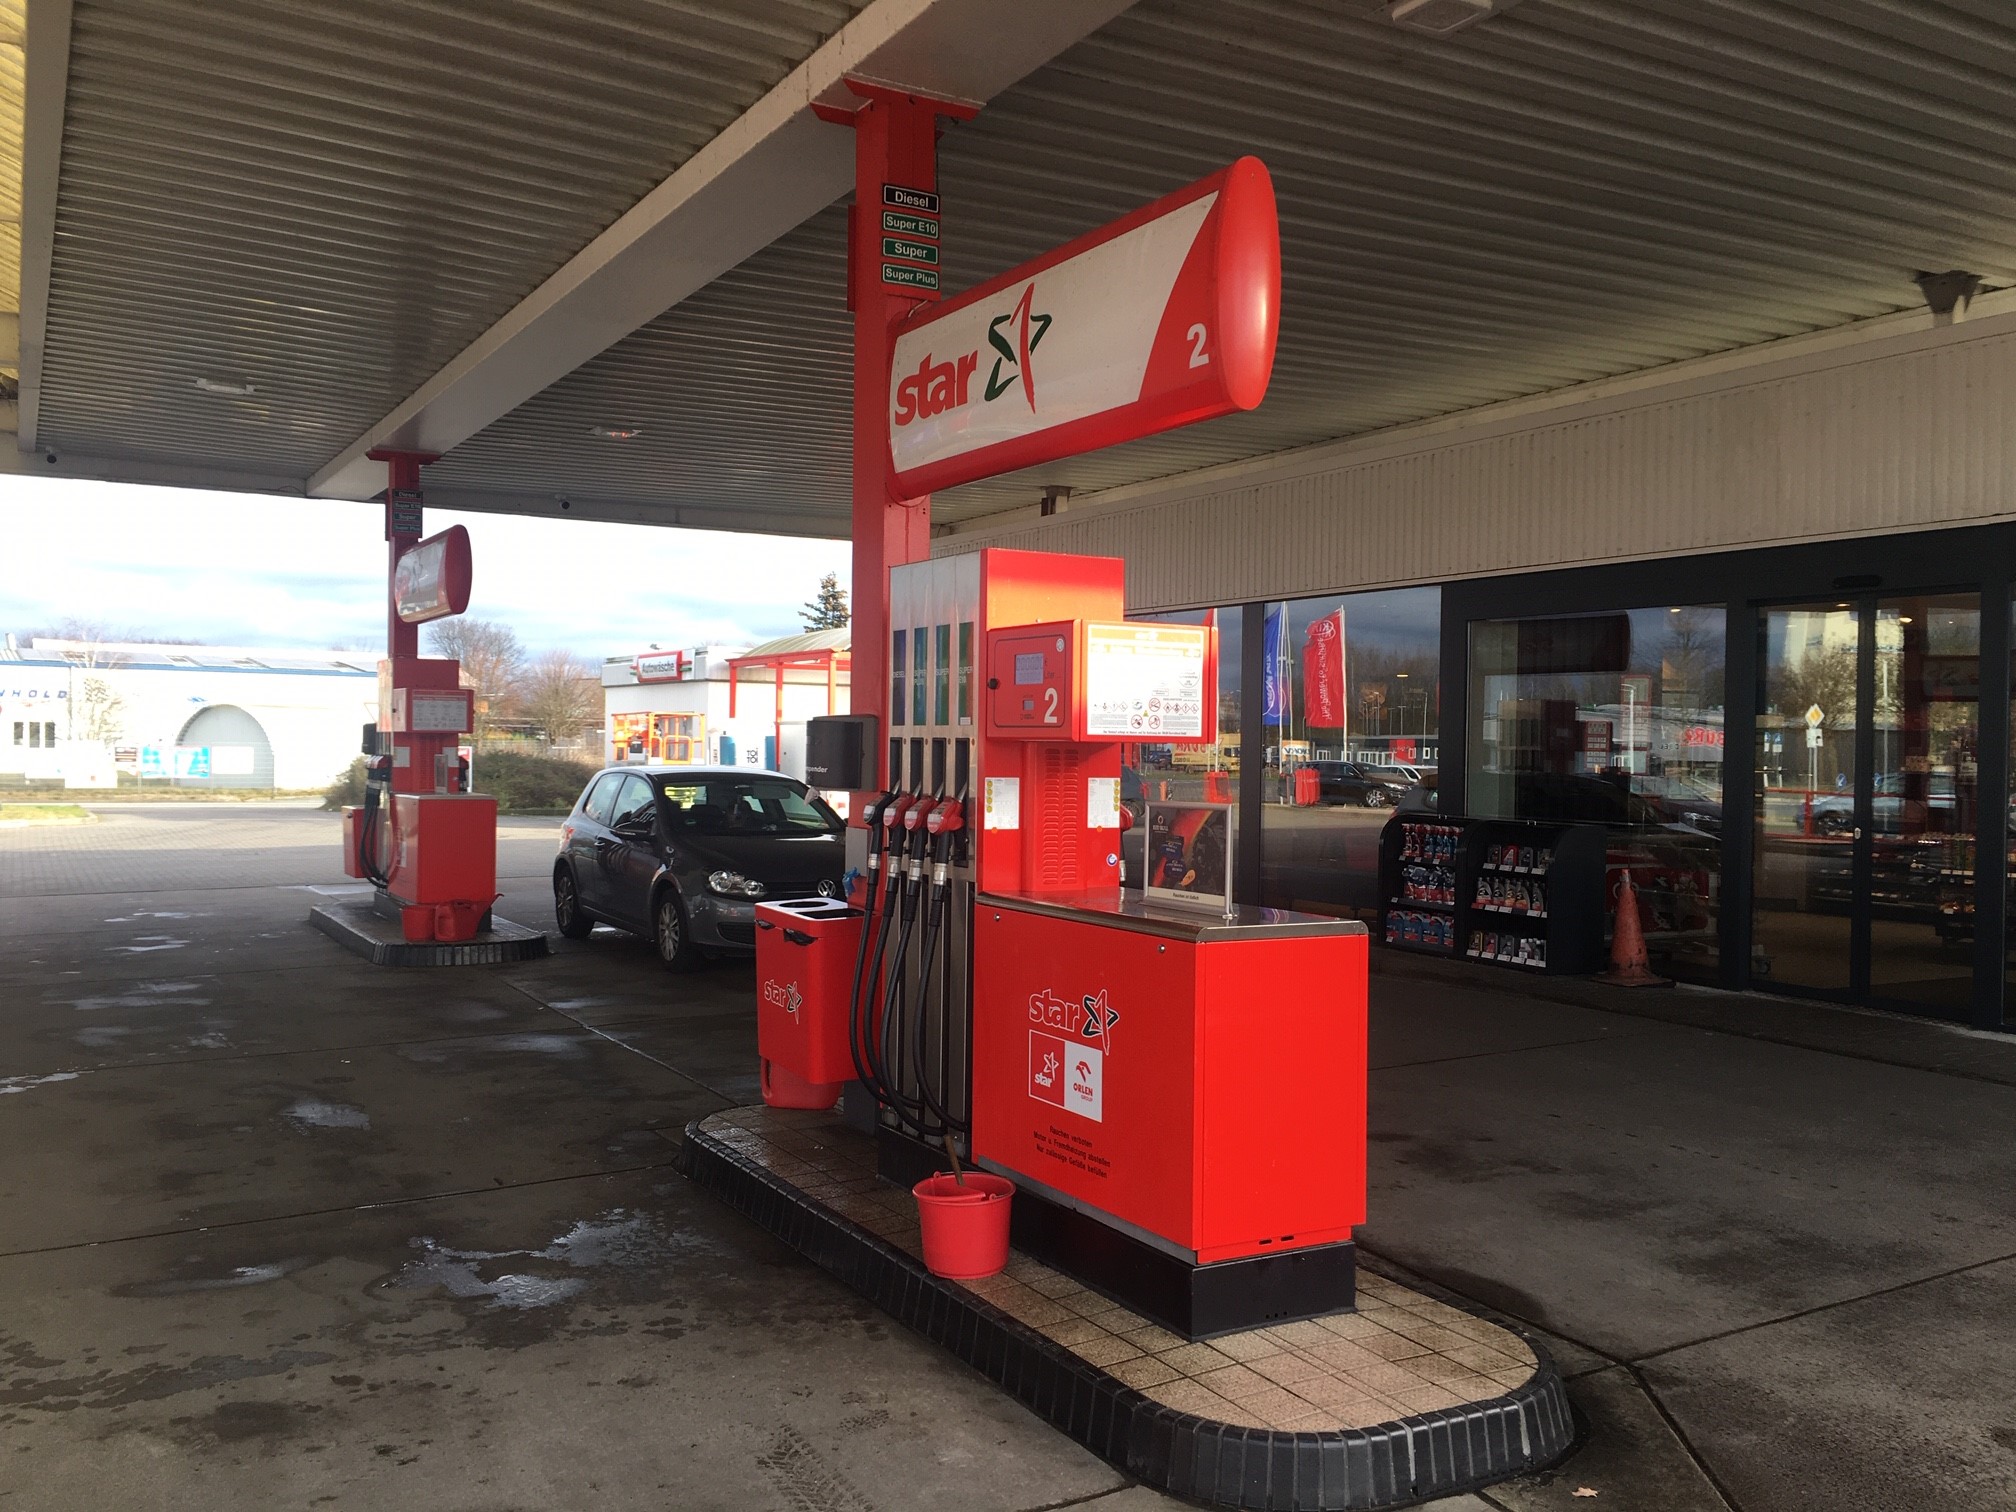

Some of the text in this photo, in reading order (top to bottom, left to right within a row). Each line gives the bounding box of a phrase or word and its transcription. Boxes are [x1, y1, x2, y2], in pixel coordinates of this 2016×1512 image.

[895, 191, 929, 208] Diesel
[886, 215, 936, 234] Super E10
[894, 242, 928, 258] Super
[885, 267, 936, 285] Super Plus
[1185, 322, 1210, 369] 2
[894, 350, 978, 426] star
[1043, 687, 1058, 724] 2
[763, 979, 786, 1008] star
[1029, 988, 1080, 1033] star
[1034, 1072, 1053, 1088] star
[1073, 1082, 1093, 1097] ORLEN
[1033, 1130, 1047, 1142] Motor
[1049, 1125, 1093, 1148] Rauchen verboten
[1036, 1143, 1044, 1153] Nur
